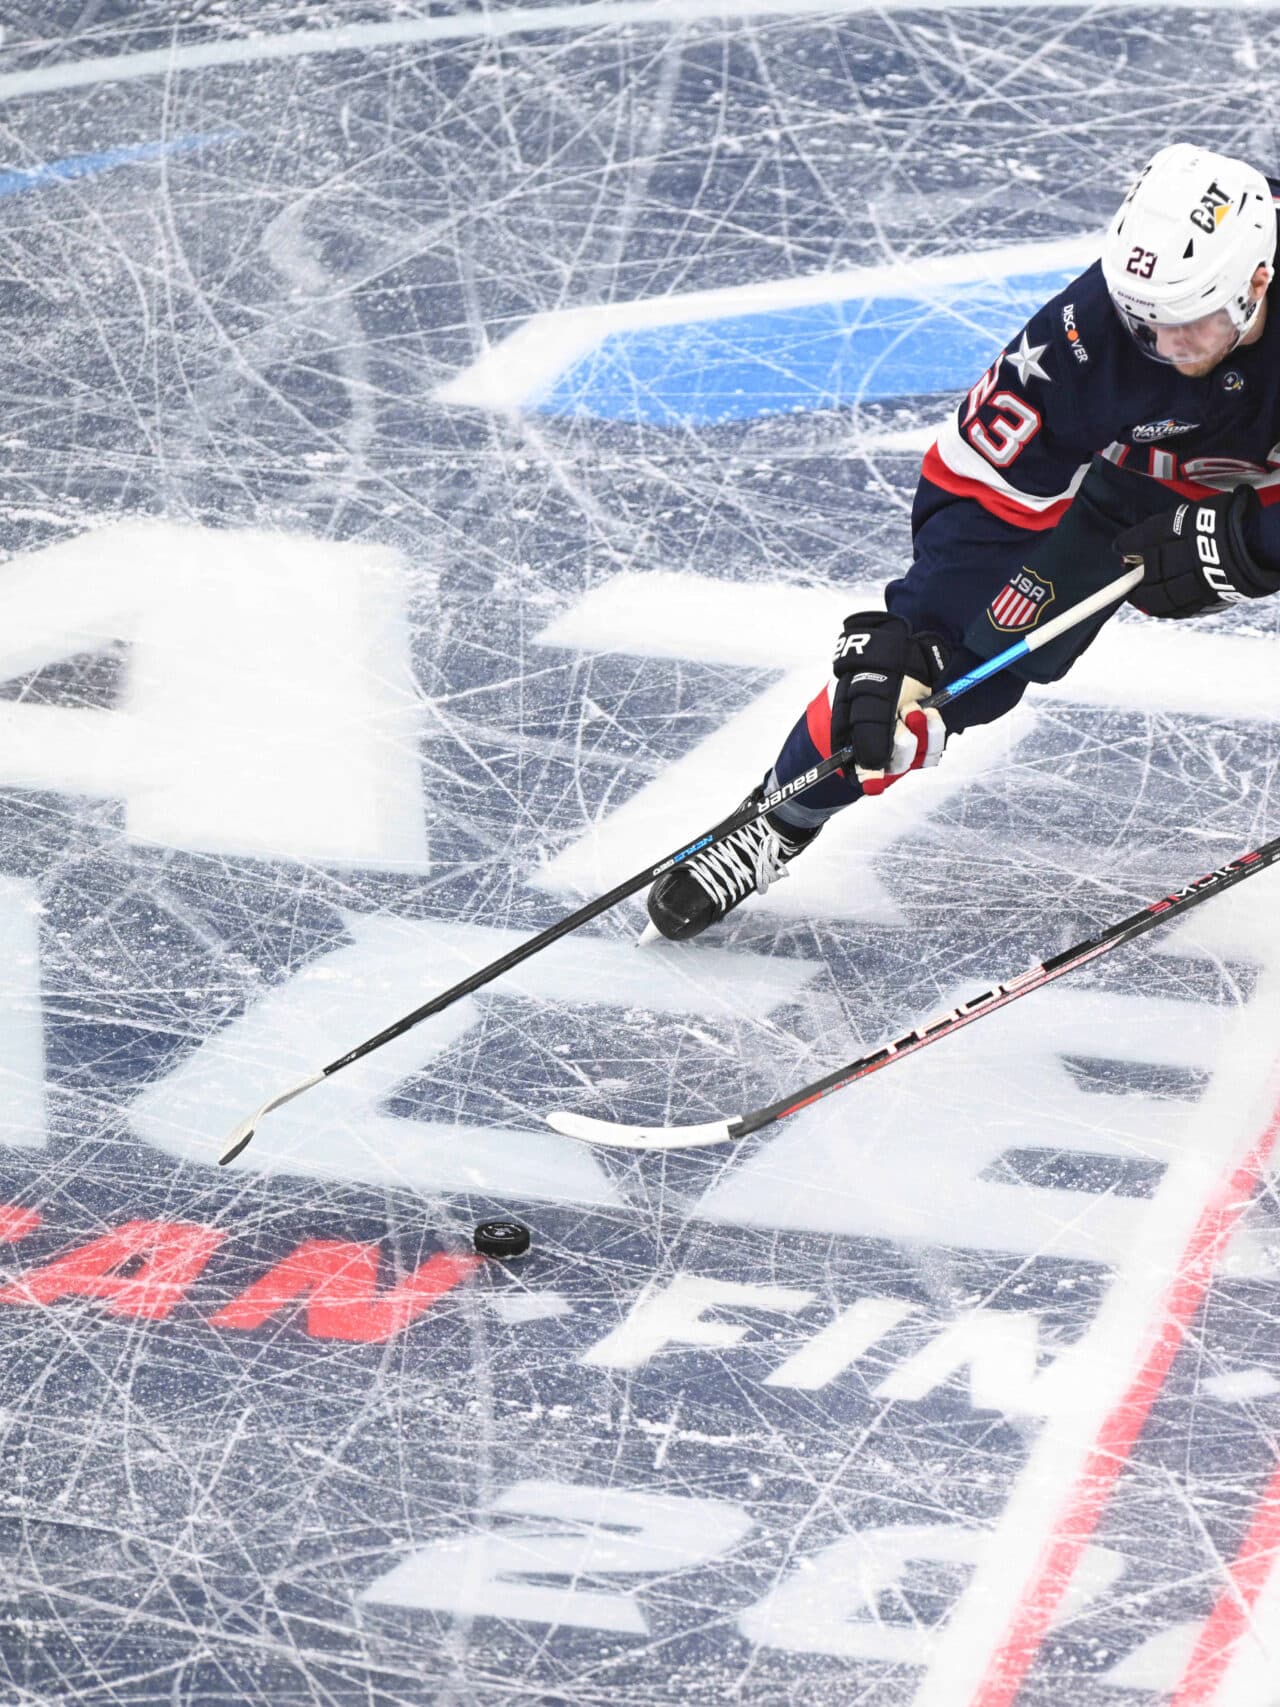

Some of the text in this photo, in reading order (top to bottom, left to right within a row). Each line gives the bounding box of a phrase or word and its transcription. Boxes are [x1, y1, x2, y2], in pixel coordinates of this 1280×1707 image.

[1190, 182, 1231, 234] CAT
[1126, 247, 1158, 279] 23
[1063, 304, 1088, 363] DISCOVER
[960, 350, 1042, 468] 23
[1196, 507, 1250, 604] BAUE
[757, 767, 819, 814] BAUER
[1146, 852, 1262, 914] SMOKE
[0, 1205, 485, 1343] AN
[577, 1272, 1135, 1420] FIN
